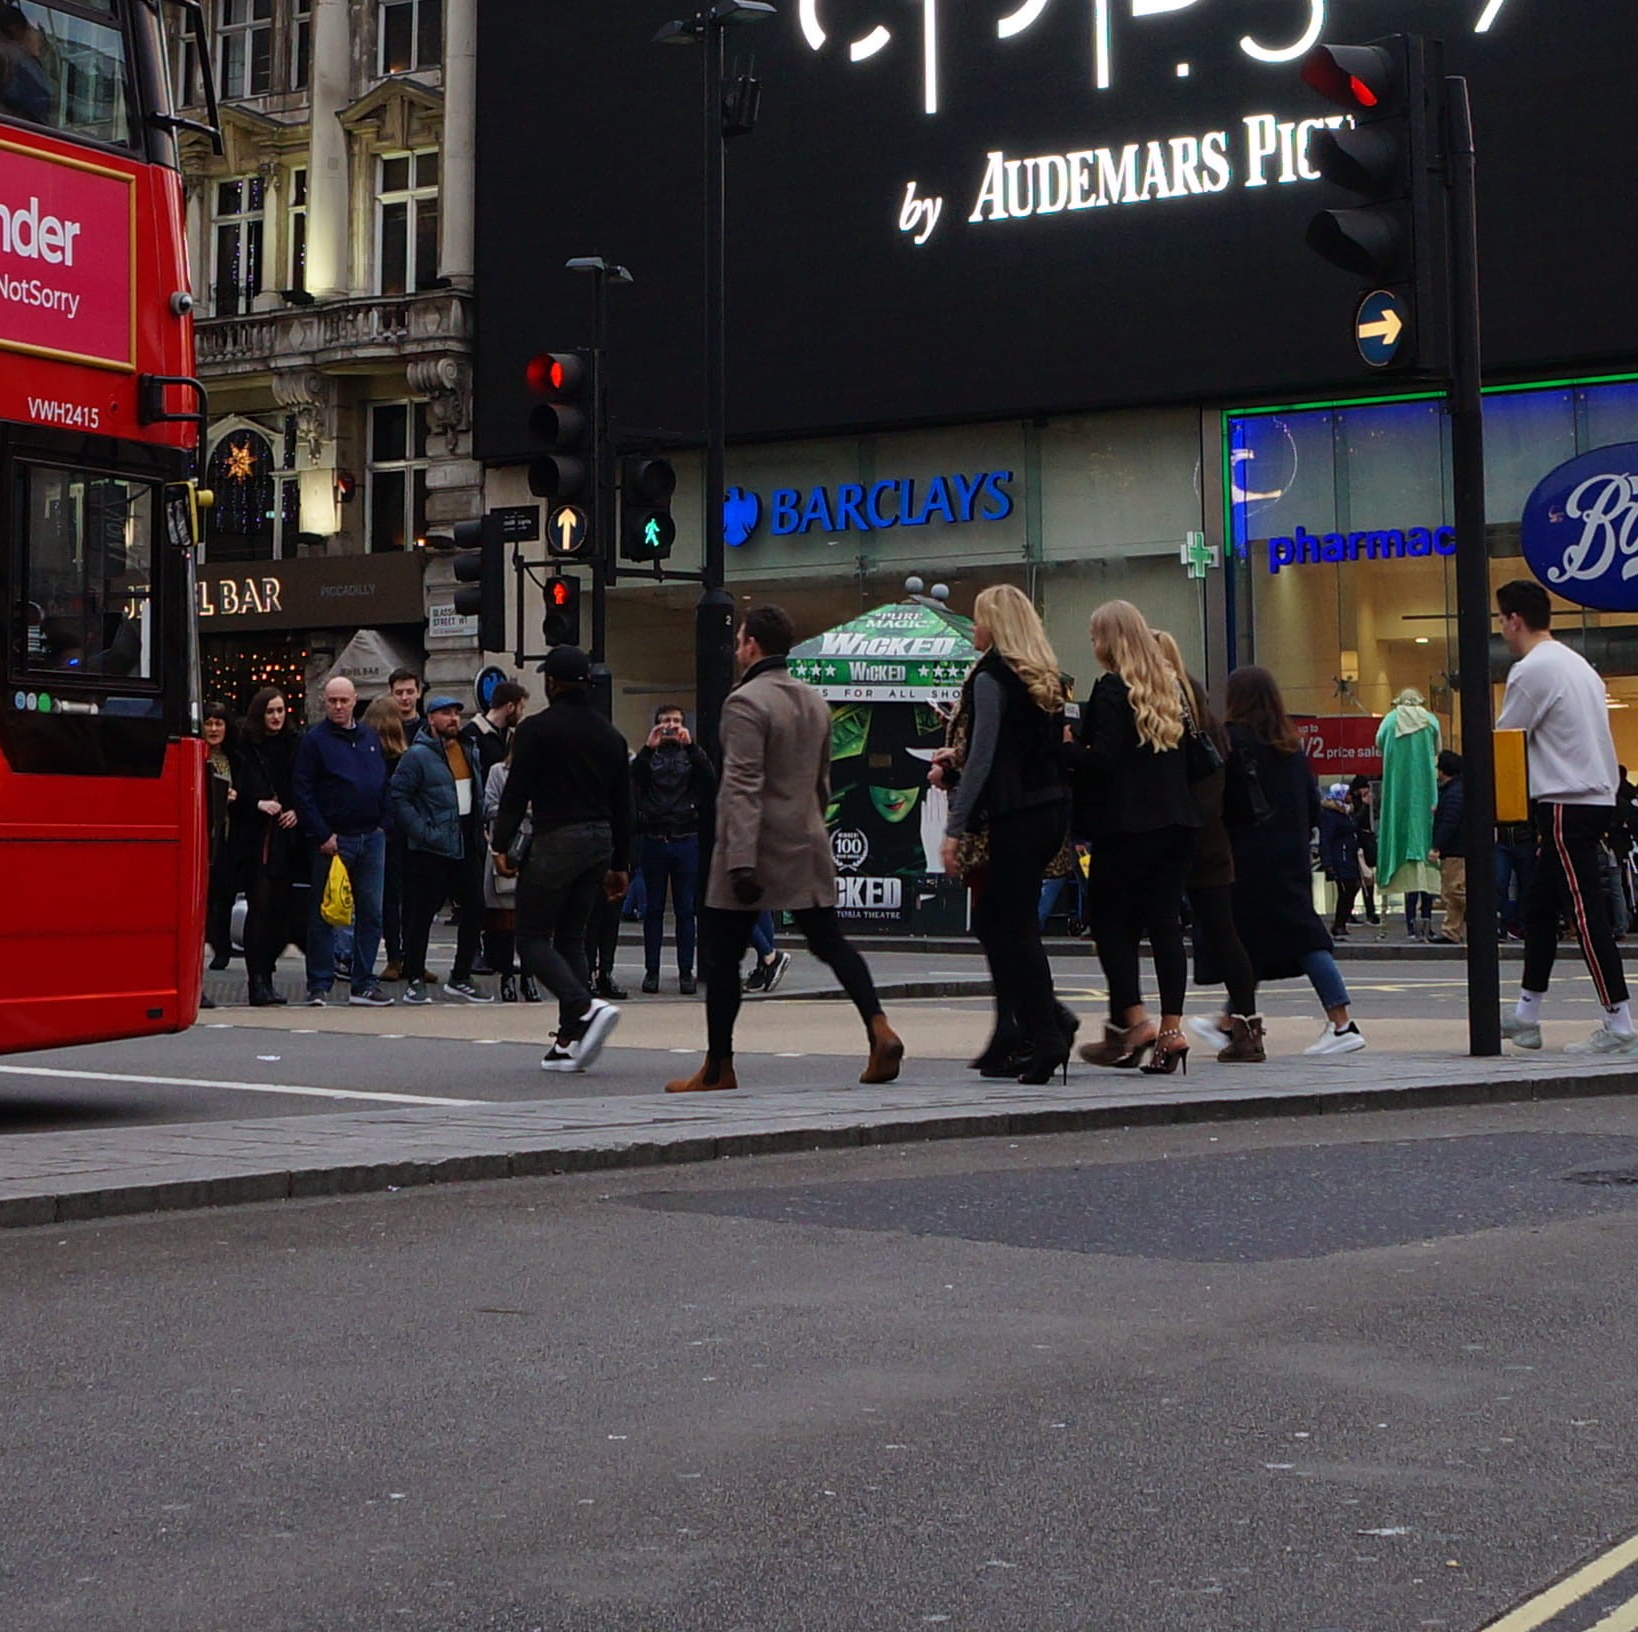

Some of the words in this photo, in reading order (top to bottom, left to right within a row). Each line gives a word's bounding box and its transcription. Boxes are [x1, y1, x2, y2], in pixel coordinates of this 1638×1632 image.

[898, 182, 943, 245] by
[968, 129, 1231, 223] AUDEMARS
[27, 396, 100, 429] VWH2415
[770, 470, 1014, 537] BARCLAYS
[219, 577, 283, 615] BAR
[320, 583, 376, 597] PICCADILLY
[844, 689, 874, 698] FOR
[889, 689, 916, 698] ALL
[1310, 724, 1319, 733] to
[1326, 747, 1354, 760] price
[835, 838, 862, 854] 100
